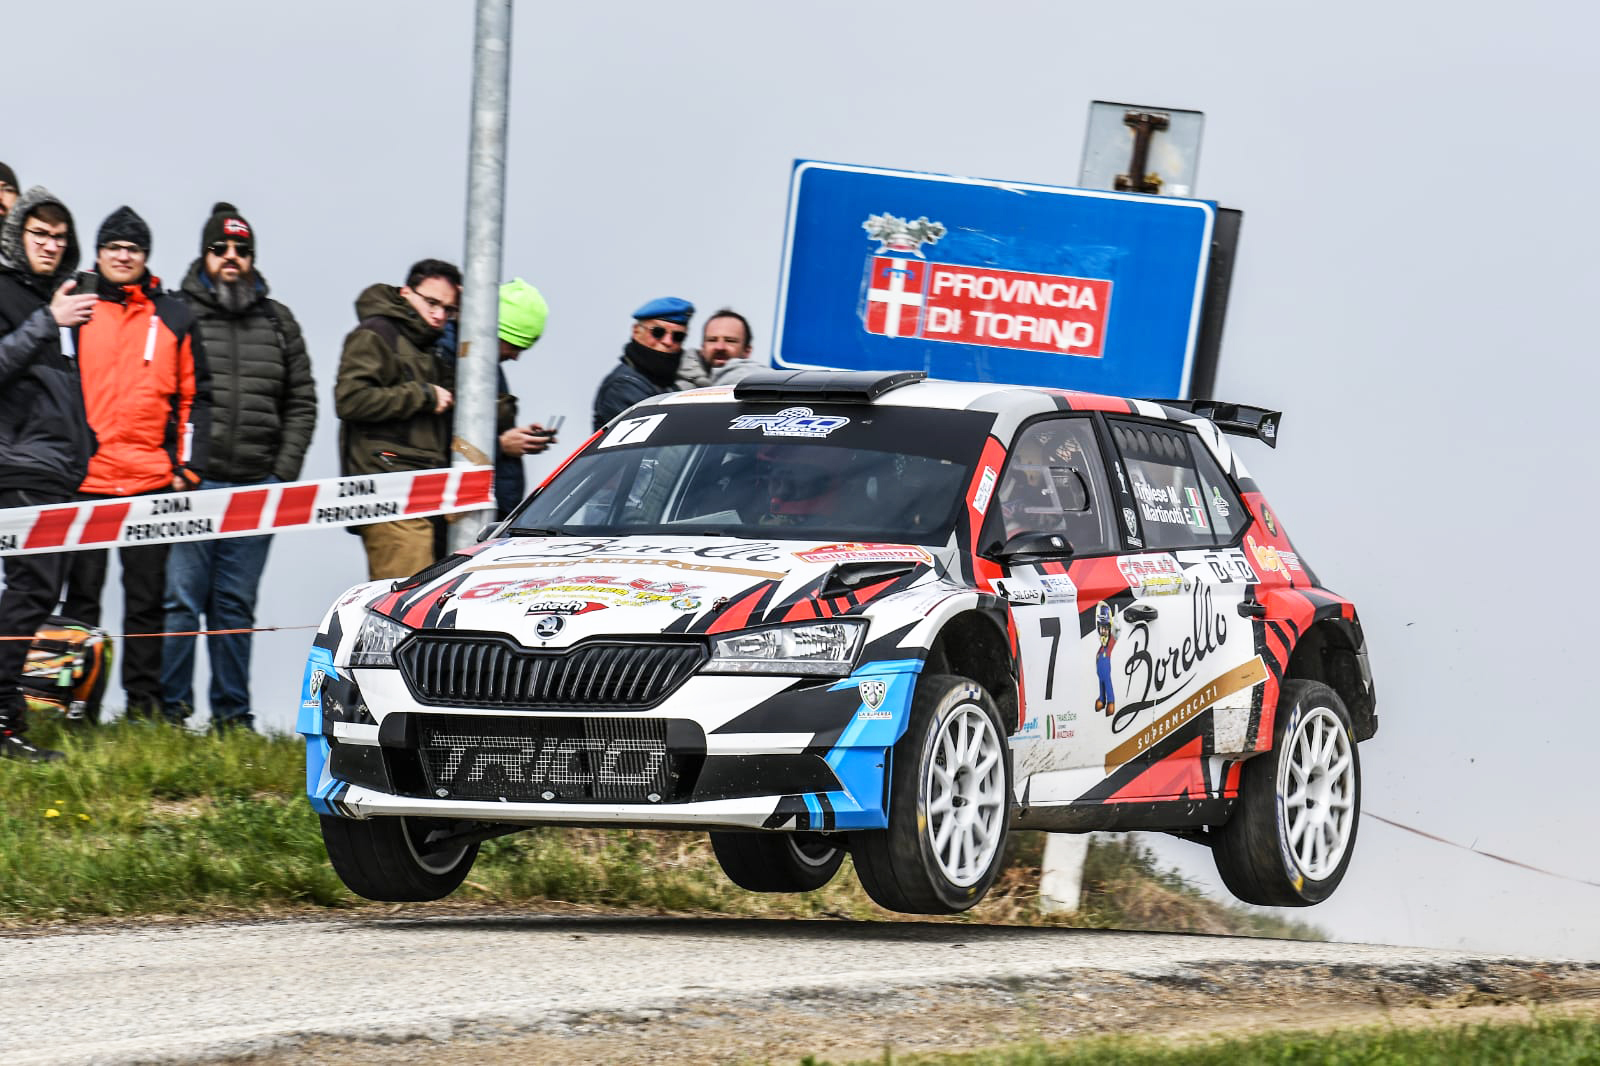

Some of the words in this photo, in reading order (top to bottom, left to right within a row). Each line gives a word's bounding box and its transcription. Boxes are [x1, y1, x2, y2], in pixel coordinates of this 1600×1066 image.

[933, 271, 1098, 312] PROVINCIA
[928, 306, 961, 335] DI
[971, 310, 1094, 351] TORINO
[618, 418, 651, 443] 7
[730, 414, 850, 432] TRICO
[338, 479, 377, 498] ZONA
[150, 497, 191, 516] ZONA
[317, 501, 399, 524] PERICOLOSA
[1141, 503, 1186, 525] Martinotti
[125, 518, 214, 541] PERICOLOSA
[530, 600, 588, 611] atech
[1013, 589, 1039, 600] SILGAS
[1040, 617, 1061, 700] 7
[1112, 575, 1227, 734] Borello
[1137, 685, 1218, 750] SUPERMERCATI
[431, 735, 667, 784] TRICO
